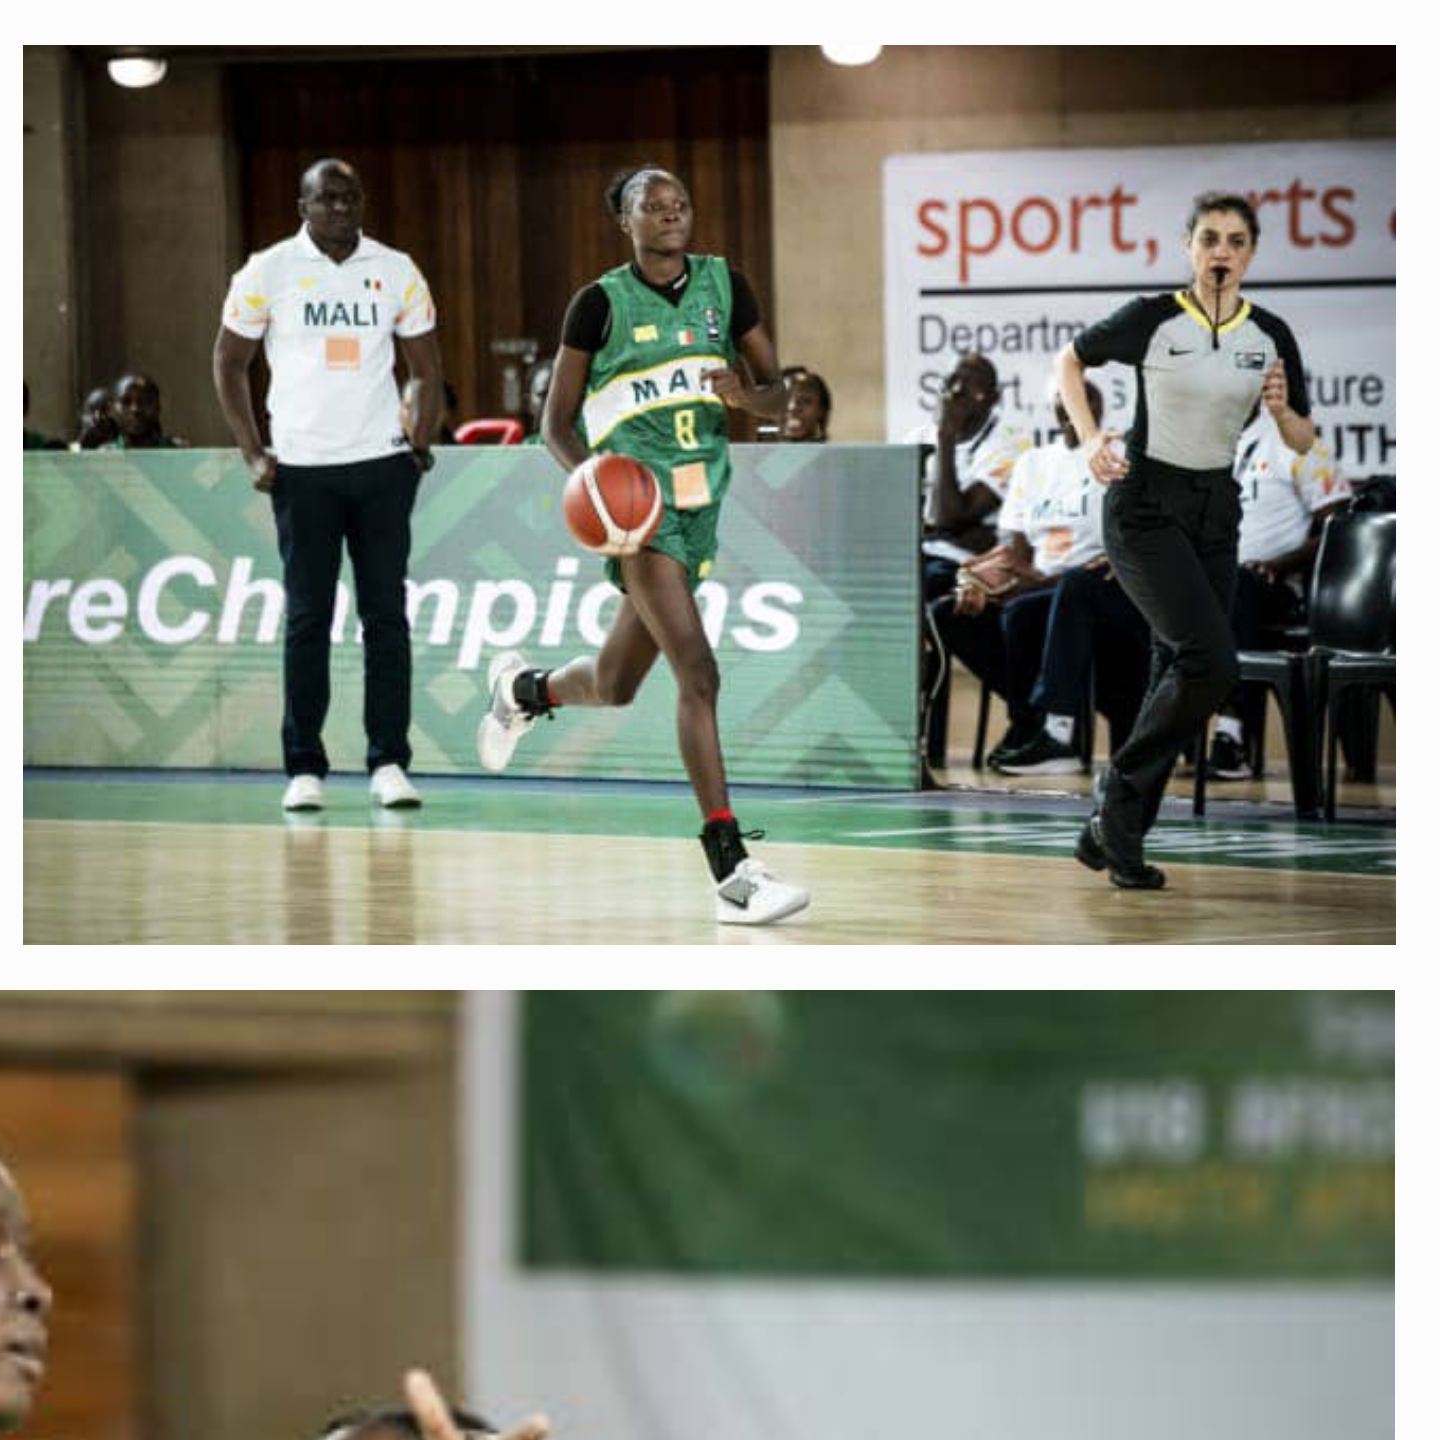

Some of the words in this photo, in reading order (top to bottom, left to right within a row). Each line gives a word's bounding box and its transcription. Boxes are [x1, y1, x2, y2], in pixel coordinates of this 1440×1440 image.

[916, 182, 1160, 285] sport,
[303, 302, 379, 327] MALI
[919, 313, 1087, 356] Departm
[630, 366, 709, 404] MA
[674, 409, 700, 451] 8
